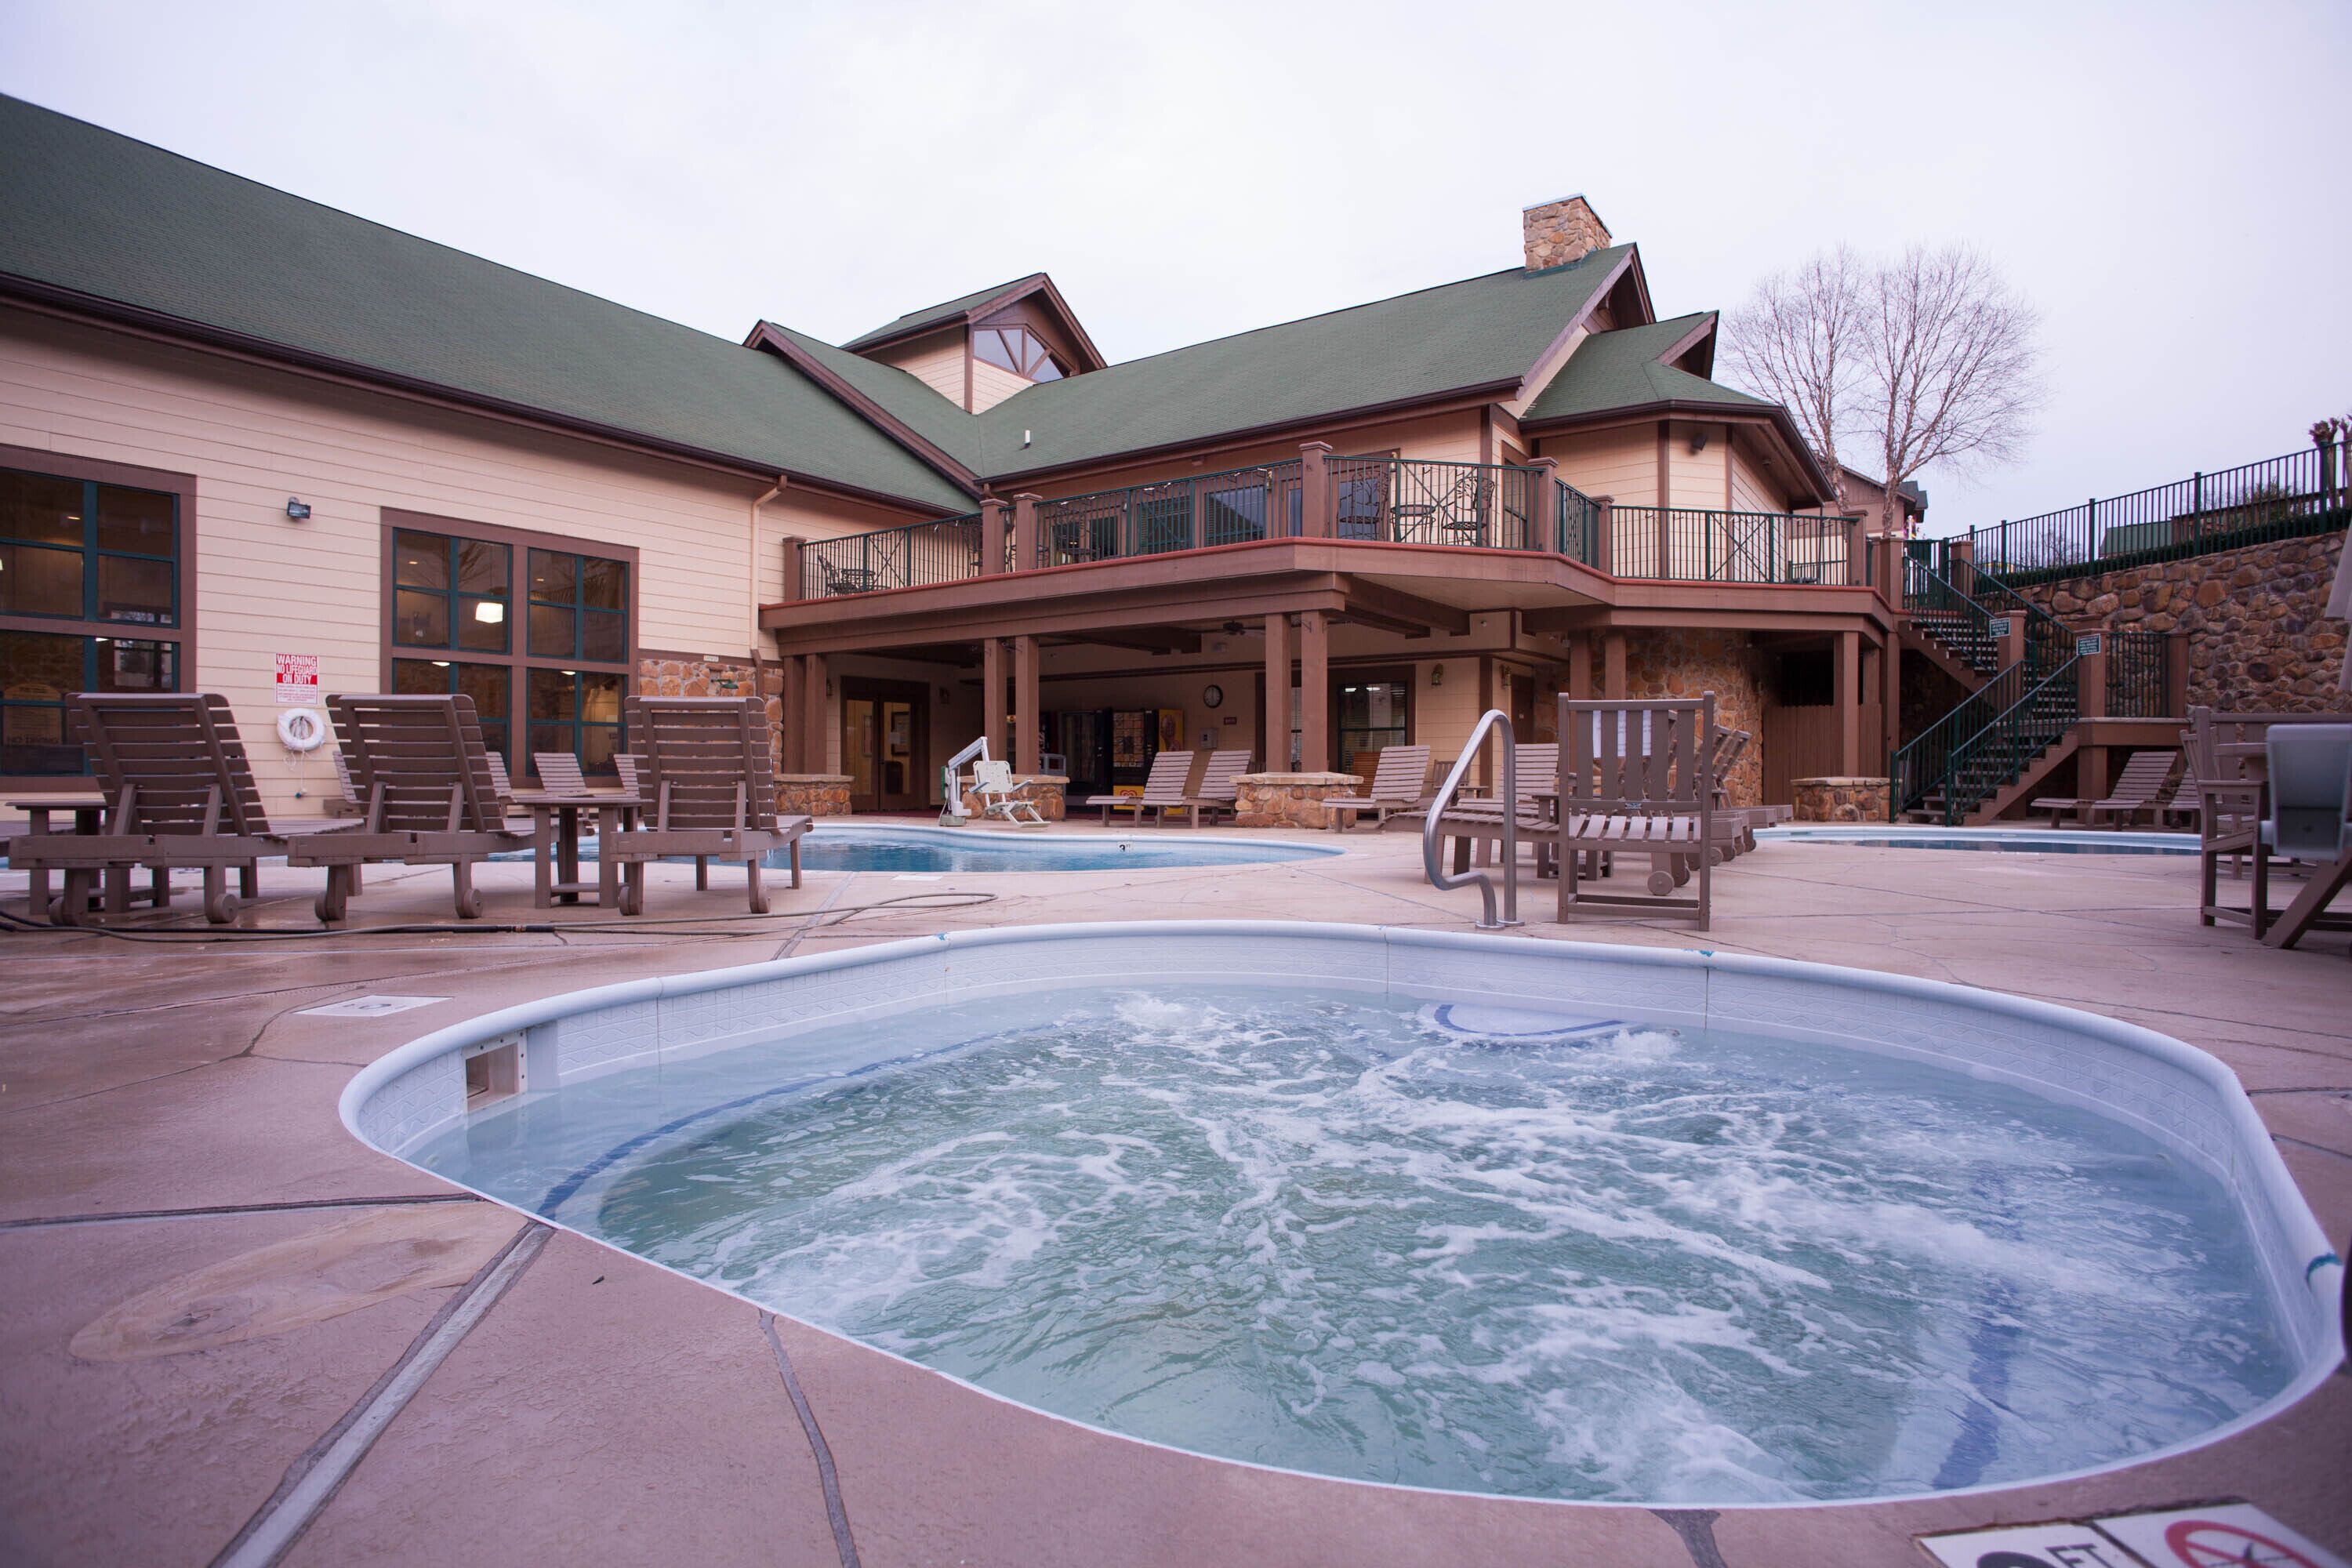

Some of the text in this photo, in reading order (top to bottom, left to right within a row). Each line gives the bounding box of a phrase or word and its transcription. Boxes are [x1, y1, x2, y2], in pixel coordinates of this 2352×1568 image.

[277, 655, 317, 666] WARNING
[276, 664, 317, 675] NO LIFEGUARD
[282, 673, 311, 684] ON DUTY
